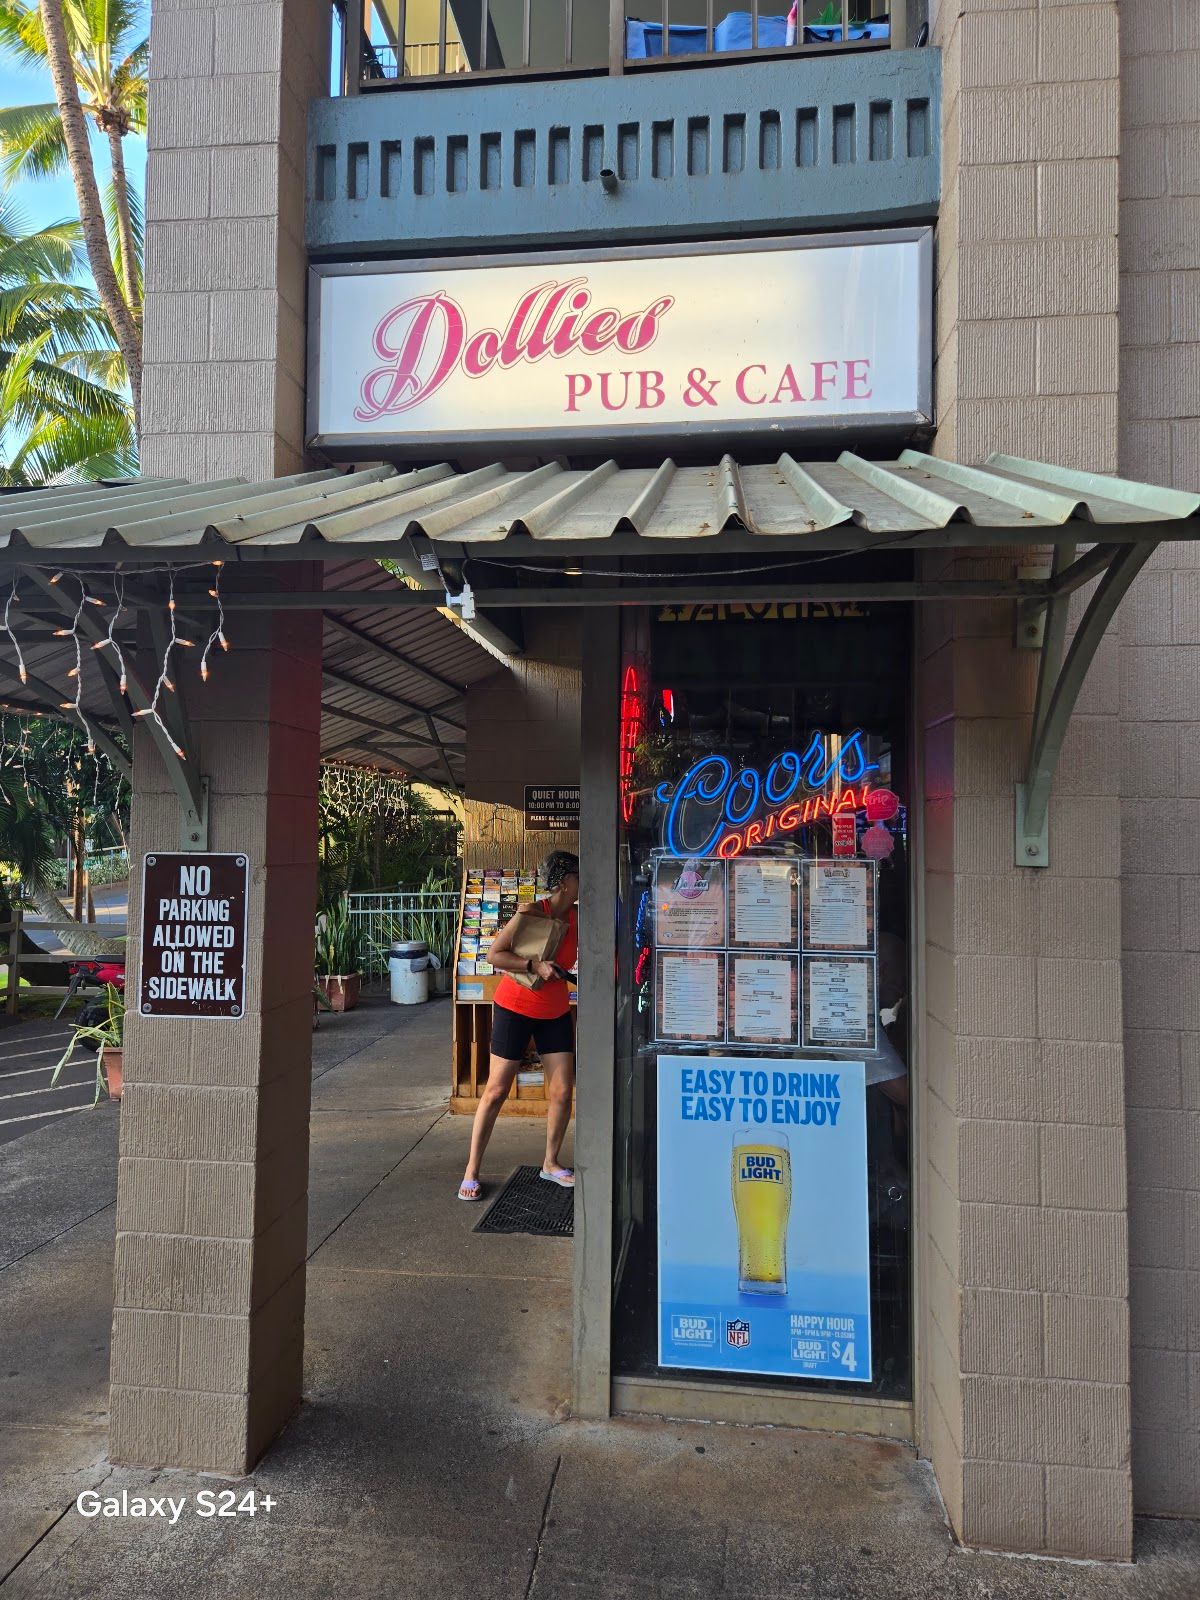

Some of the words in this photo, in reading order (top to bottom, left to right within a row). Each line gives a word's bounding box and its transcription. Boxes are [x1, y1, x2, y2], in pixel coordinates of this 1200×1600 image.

[353, 276, 675, 422] Dollies
[564, 369, 666, 412] PUB
[682, 366, 718, 407] &
[736, 359, 873, 405] CAFE
[532, 790, 555, 800] QUIET
[558, 790, 580, 799] HOUR
[654, 729, 879, 858] Coors
[717, 785, 869, 858] ORIGINAL
[180, 865, 211, 896] NO
[159, 898, 230, 922] PARKING
[152, 924, 234, 948] ALLOWED
[161, 950, 185, 974] ON
[191, 952, 224, 974] THE
[148, 977, 236, 1001] SIDEWALK
[681, 1069, 736, 1094] EASY
[740, 1071, 768, 1096] TO
[772, 1072, 841, 1099] DRINK
[681, 1096, 736, 1122] EASY
[738, 1098, 768, 1124] TO
[772, 1099, 841, 1126] ENJOY
[741, 1167, 782, 1181] LIGHT
[746, 1156, 776, 1168] BUD
[674, 1328, 712, 1340] LIGHT
[680, 1318, 708, 1330] BUD
[790, 1314, 824, 1330] HAPPY
[826, 1317, 854, 1331] HOUR
[728, 1331, 748, 1345] NFL
[798, 1340, 822, 1350] BUD
[793, 1348, 826, 1360] LIGHT
